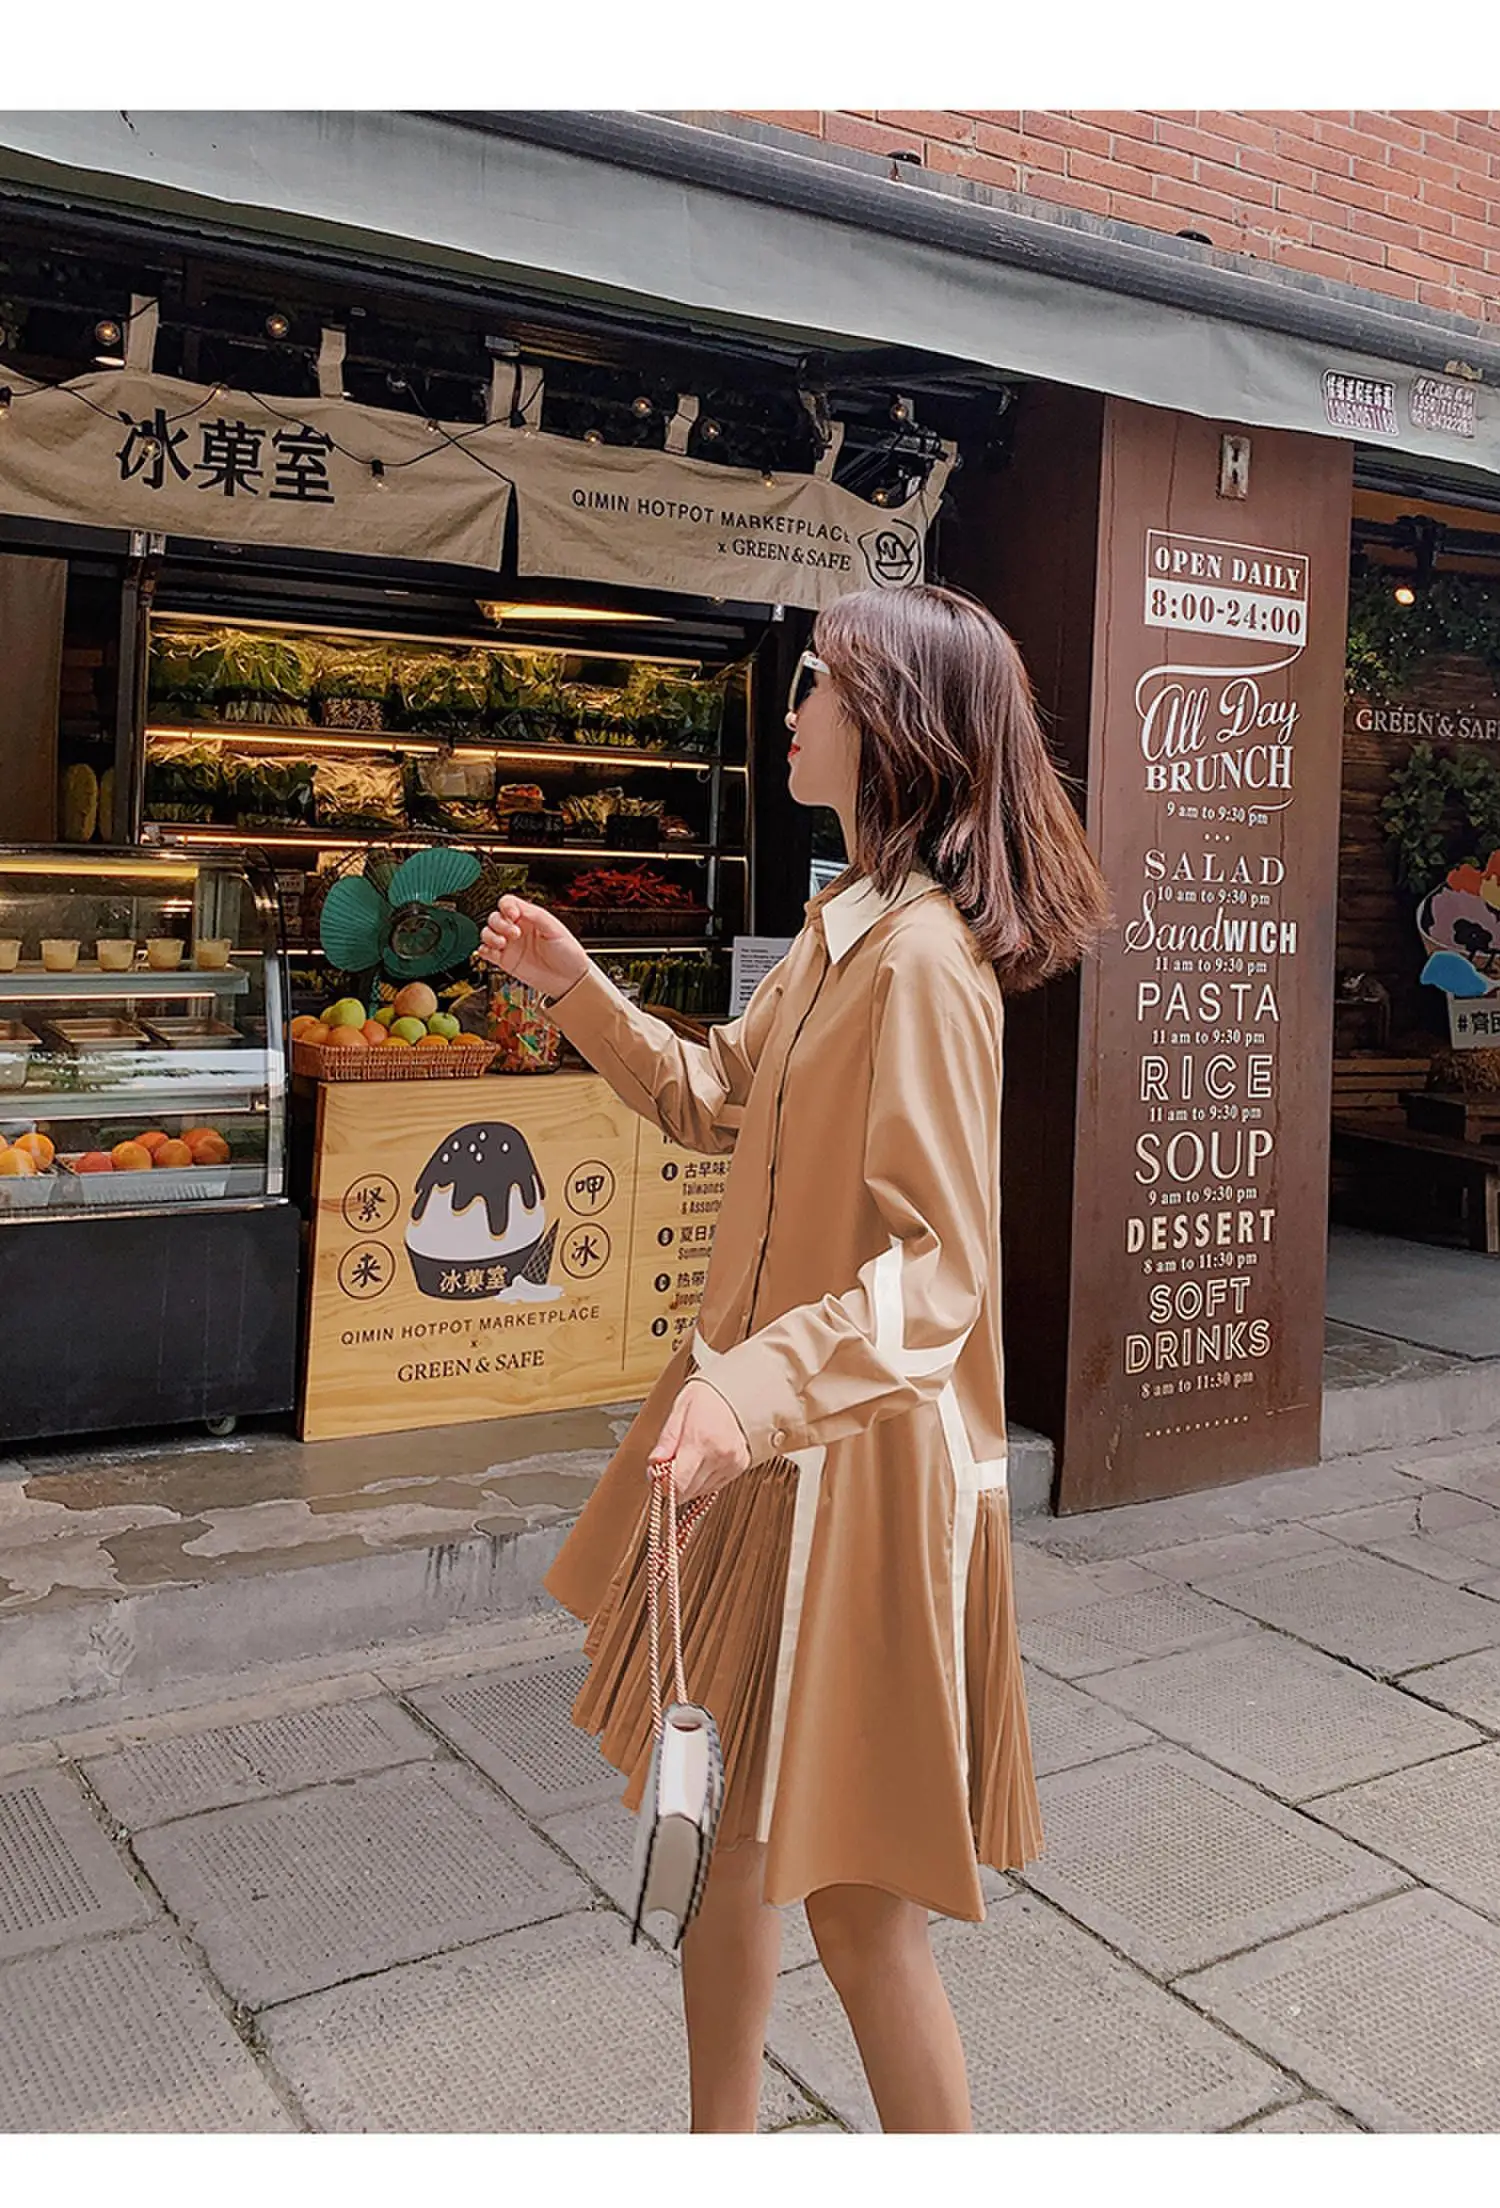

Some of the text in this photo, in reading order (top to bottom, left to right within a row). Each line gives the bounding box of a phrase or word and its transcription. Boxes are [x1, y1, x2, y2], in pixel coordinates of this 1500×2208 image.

[115, 408, 336, 504] 冰菓室
[572, 488, 630, 512] QIMIN
[638, 498, 714, 525] HOTPOT
[1154, 545, 1301, 592] OPEN DAILY
[1151, 588, 1301, 636] 8:00-24:00
[1140, 677, 1301, 761] All Day
[1356, 708, 1500, 741] GREEN & SAF
[1144, 744, 1294, 792] BRUNCH
[1167, 801, 1268, 827] 9 am to 9:30 pm
[1144, 849, 1286, 886] SALAD
[1158, 886, 1271, 909] 10 am to 9:30 pm
[1155, 957, 1267, 977] 11 am to 9:30 pm
[1137, 982, 1280, 1022] PASTA
[1152, 1029, 1265, 1048] 11 am to 9:30 pm
[1140, 1054, 1273, 1101] RICE
[1150, 1105, 1262, 1122] 11 am to 9:30 pm
[684, 1160, 731, 1179] 古早味
[1135, 1129, 1274, 1185] SOUP
[575, 1174, 604, 1206] 呷
[1148, 1186, 1257, 1206] 9 am to 9:30 pm
[1126, 1208, 1276, 1254] DESSERT
[570, 1235, 601, 1267] 冰
[1155, 1259, 1177, 1273] am
[1181, 1256, 1195, 1271] to
[1237, 1252, 1257, 1269] pm
[1149, 1276, 1251, 1324] SOFT
[341, 1305, 600, 1345] QIMIN HOTPOT MARKETPLACE
[1125, 1319, 1271, 1375] DRINKS
[397, 1357, 472, 1383] GREEN
[495, 1349, 545, 1372] SAFE
[1153, 1382, 1174, 1397] am
[1178, 1379, 1192, 1394] to
[1234, 1371, 1254, 1388] pm
